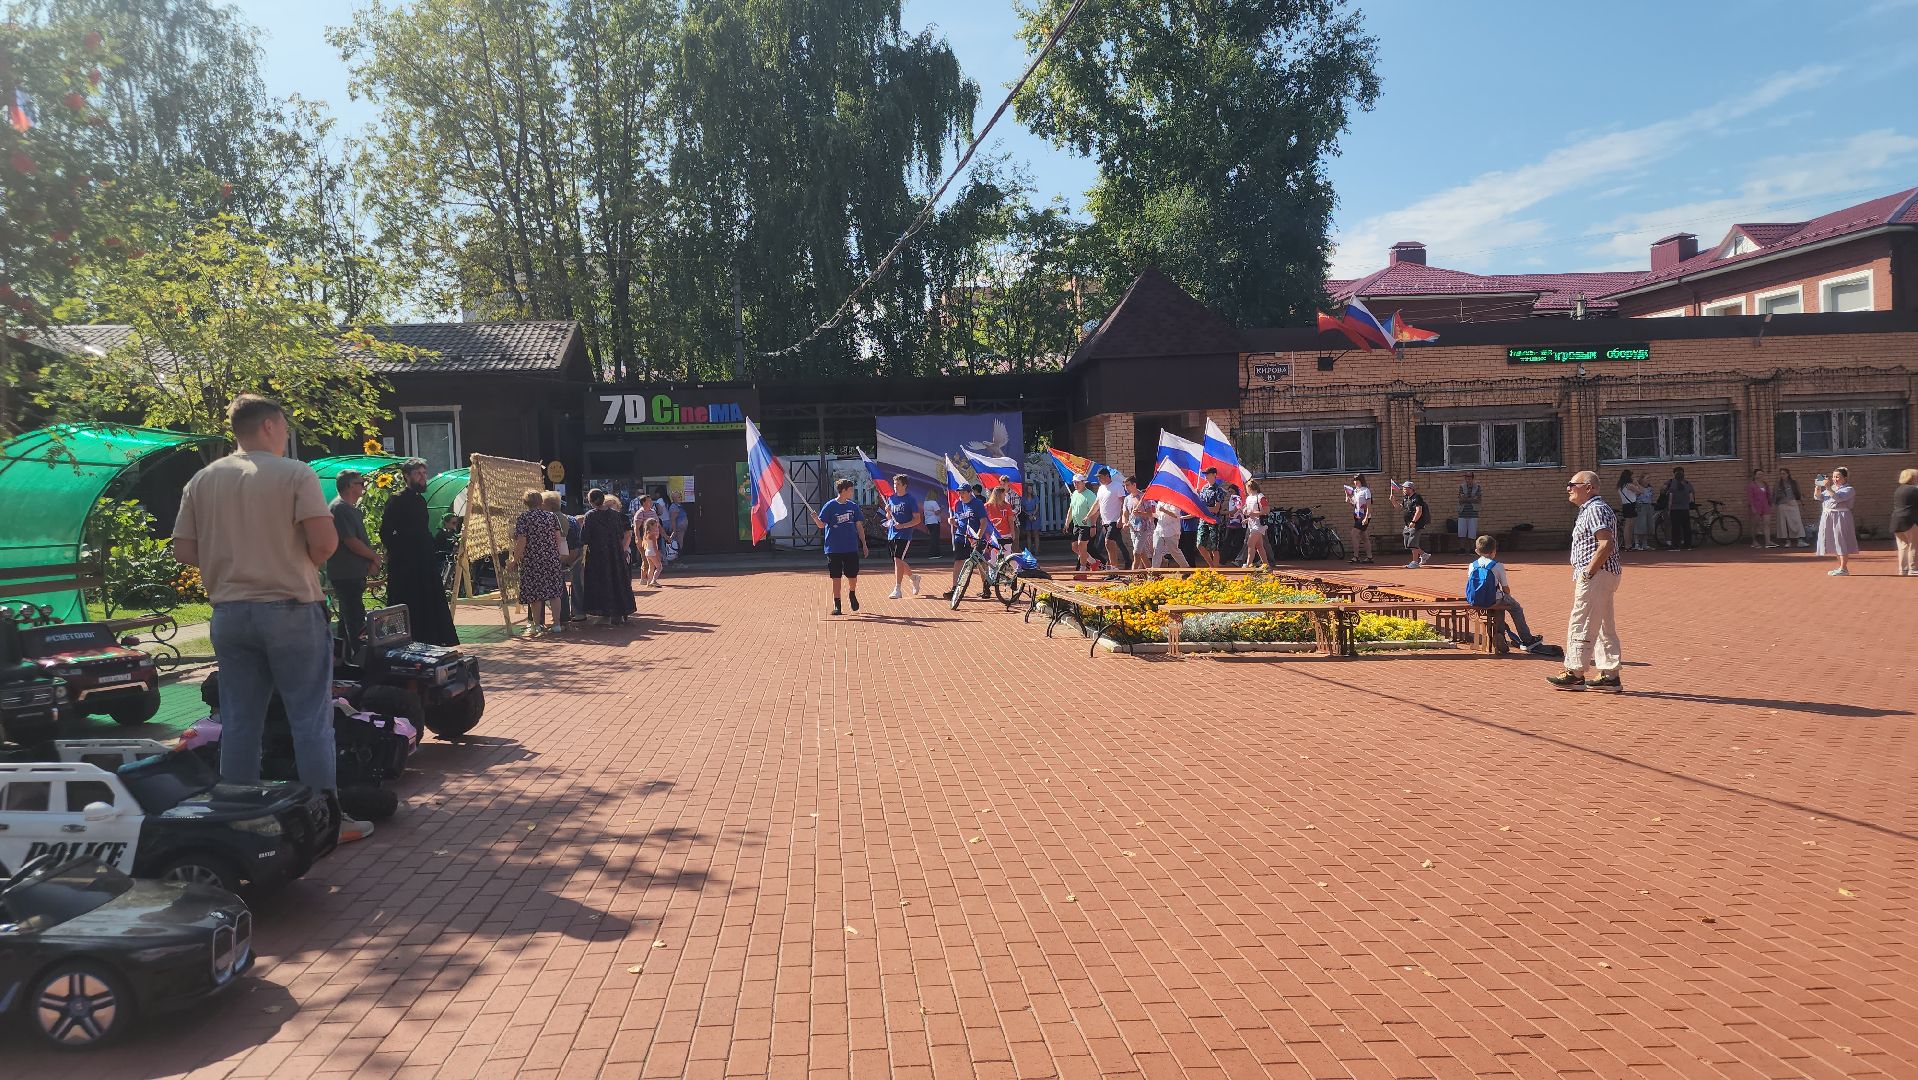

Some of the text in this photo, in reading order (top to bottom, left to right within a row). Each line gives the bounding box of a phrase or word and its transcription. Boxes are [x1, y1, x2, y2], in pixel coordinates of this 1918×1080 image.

[600, 394, 745, 425] 7D CineMA
[20, 842, 128, 868] POLICE
